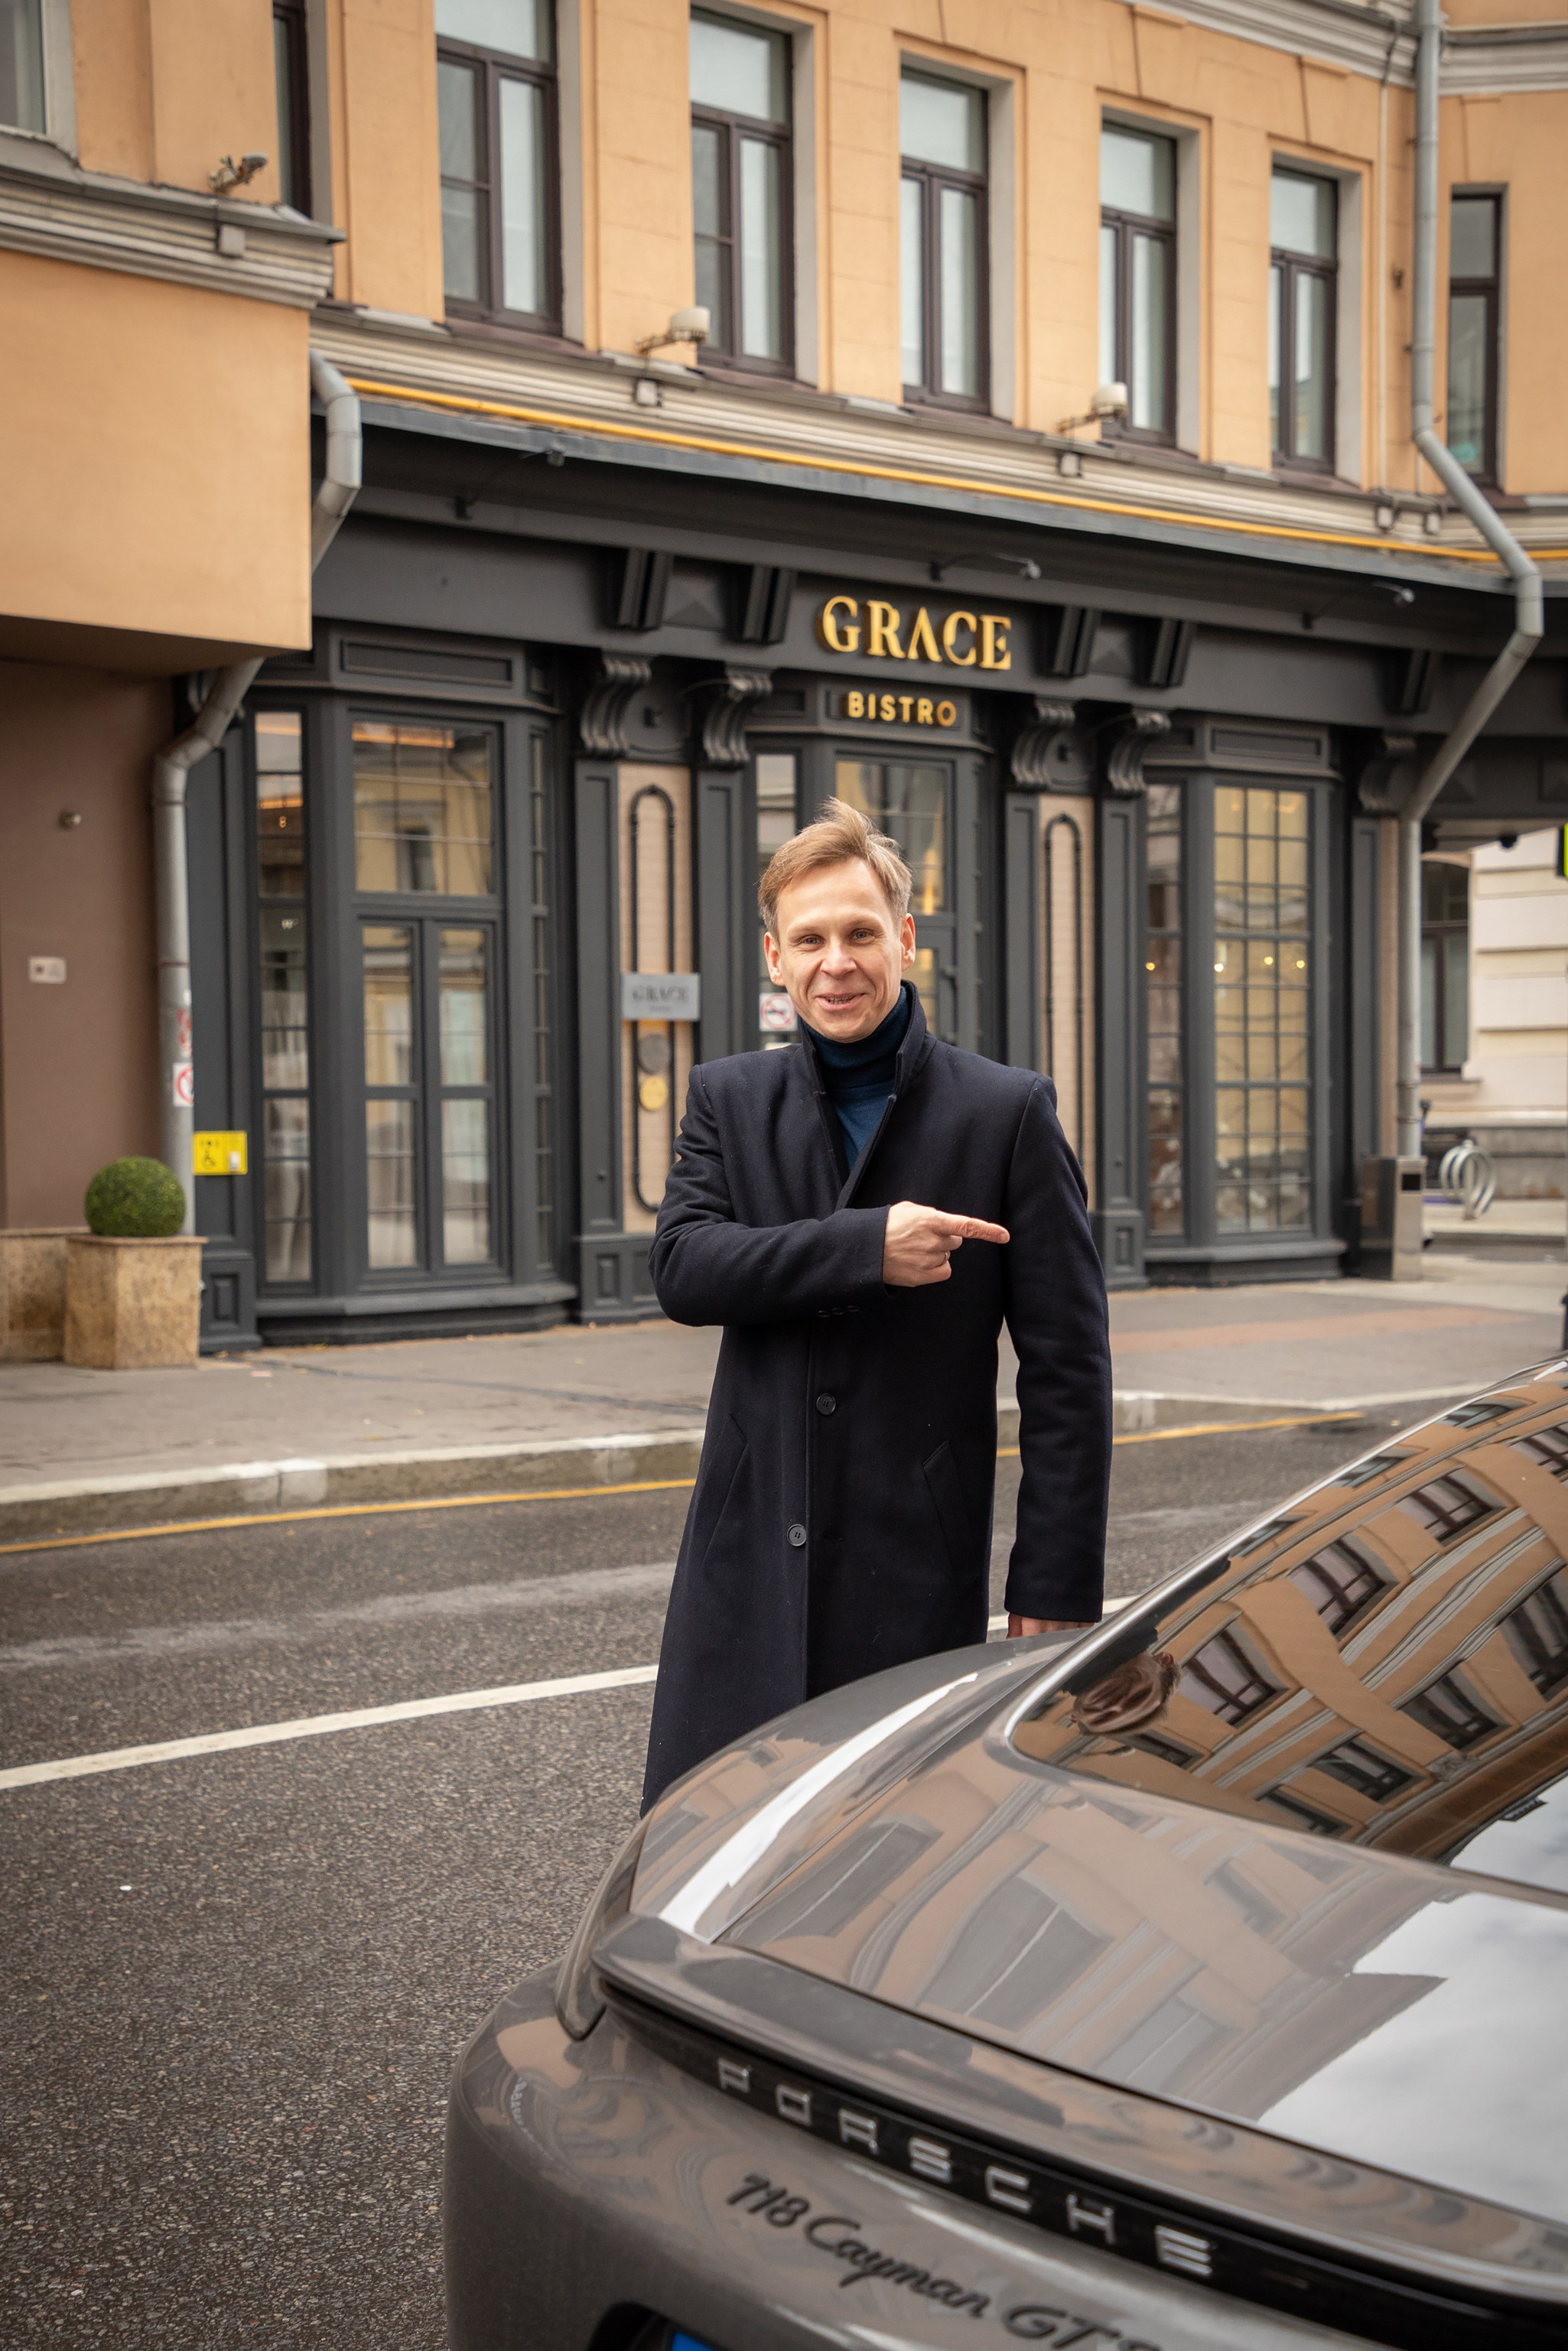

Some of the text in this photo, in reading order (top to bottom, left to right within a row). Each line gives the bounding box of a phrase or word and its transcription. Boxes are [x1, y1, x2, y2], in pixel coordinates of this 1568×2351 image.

[822, 595, 1011, 671] GRACE
[847, 691, 956, 727] BISTRO
[717, 2057, 1213, 2277] PORSCHE
[726, 2173, 1162, 2351] 718 Cayman GT
